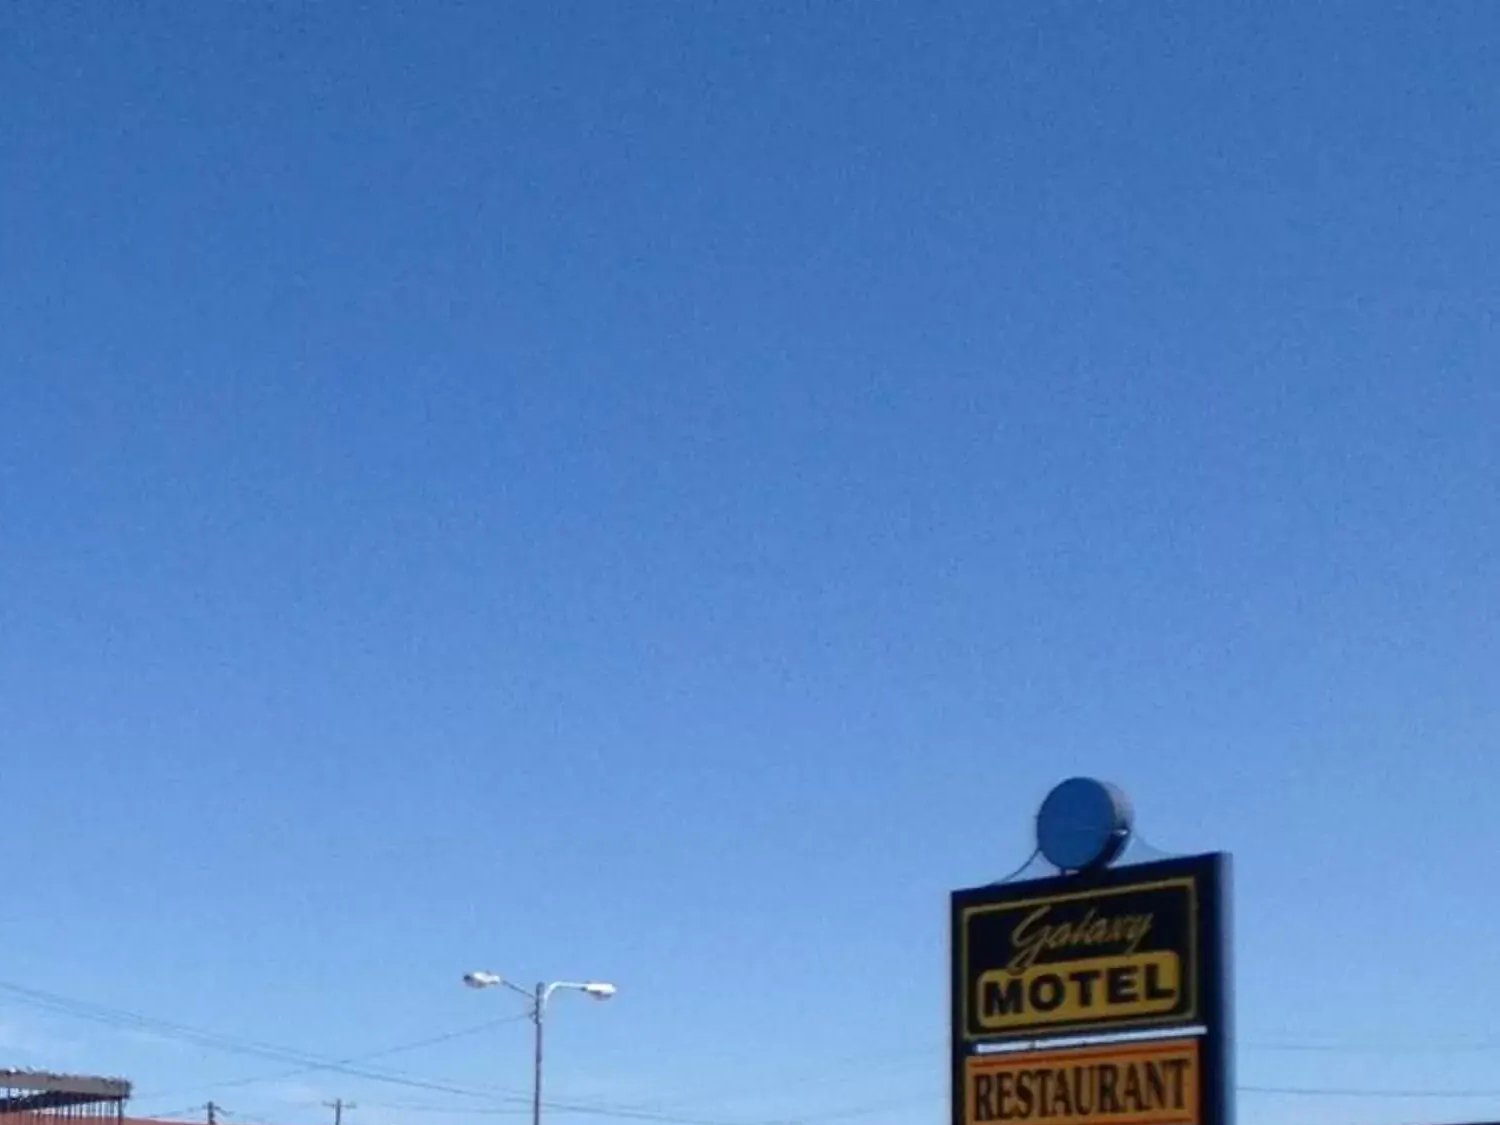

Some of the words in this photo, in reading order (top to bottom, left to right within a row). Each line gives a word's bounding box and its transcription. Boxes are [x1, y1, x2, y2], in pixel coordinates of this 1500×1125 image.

[1007, 905, 1154, 974] Galaxy
[983, 963, 1176, 1018] MOTEL
[973, 1058, 1190, 1122] RESTAURANT
